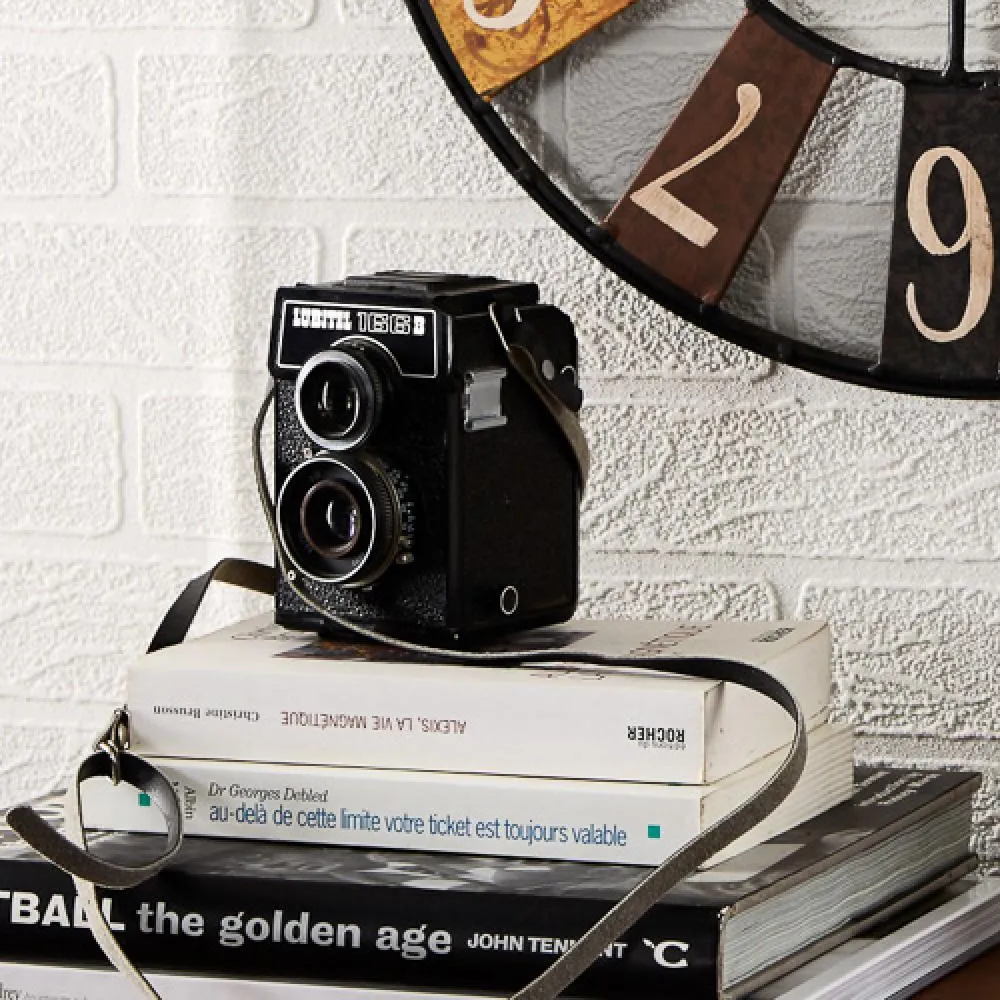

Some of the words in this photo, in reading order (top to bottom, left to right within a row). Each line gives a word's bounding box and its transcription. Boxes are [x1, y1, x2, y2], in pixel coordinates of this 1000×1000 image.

[630, 83, 761, 247] 7
[206, 707, 260, 722] Christine
[281, 711, 366, 730] MAGNÉTIQUE
[372, 714, 396, 731] VIE
[397, 716, 413, 732] LA
[418, 716, 467, 734] ALEXIS,
[627, 725, 685, 743] ROCHER
[207, 782, 226, 797] Dr
[230, 784, 281, 801] Georges
[284, 788, 328, 802] Debled
[210, 803, 267, 823] au-delà
[273, 806, 293, 827] de
[297, 809, 336, 828] cette
[341, 808, 380, 831] limite
[384, 813, 424, 834] votre
[429, 813, 471, 837] ticket
[475, 819, 500, 838] est
[504, 819, 568, 846] toujours
[572, 824, 627, 846] valable
[136, 902, 205, 937] the
[219, 909, 361, 947] golden
[375, 924, 452, 960] age
[467, 933, 523, 951] JOHN
